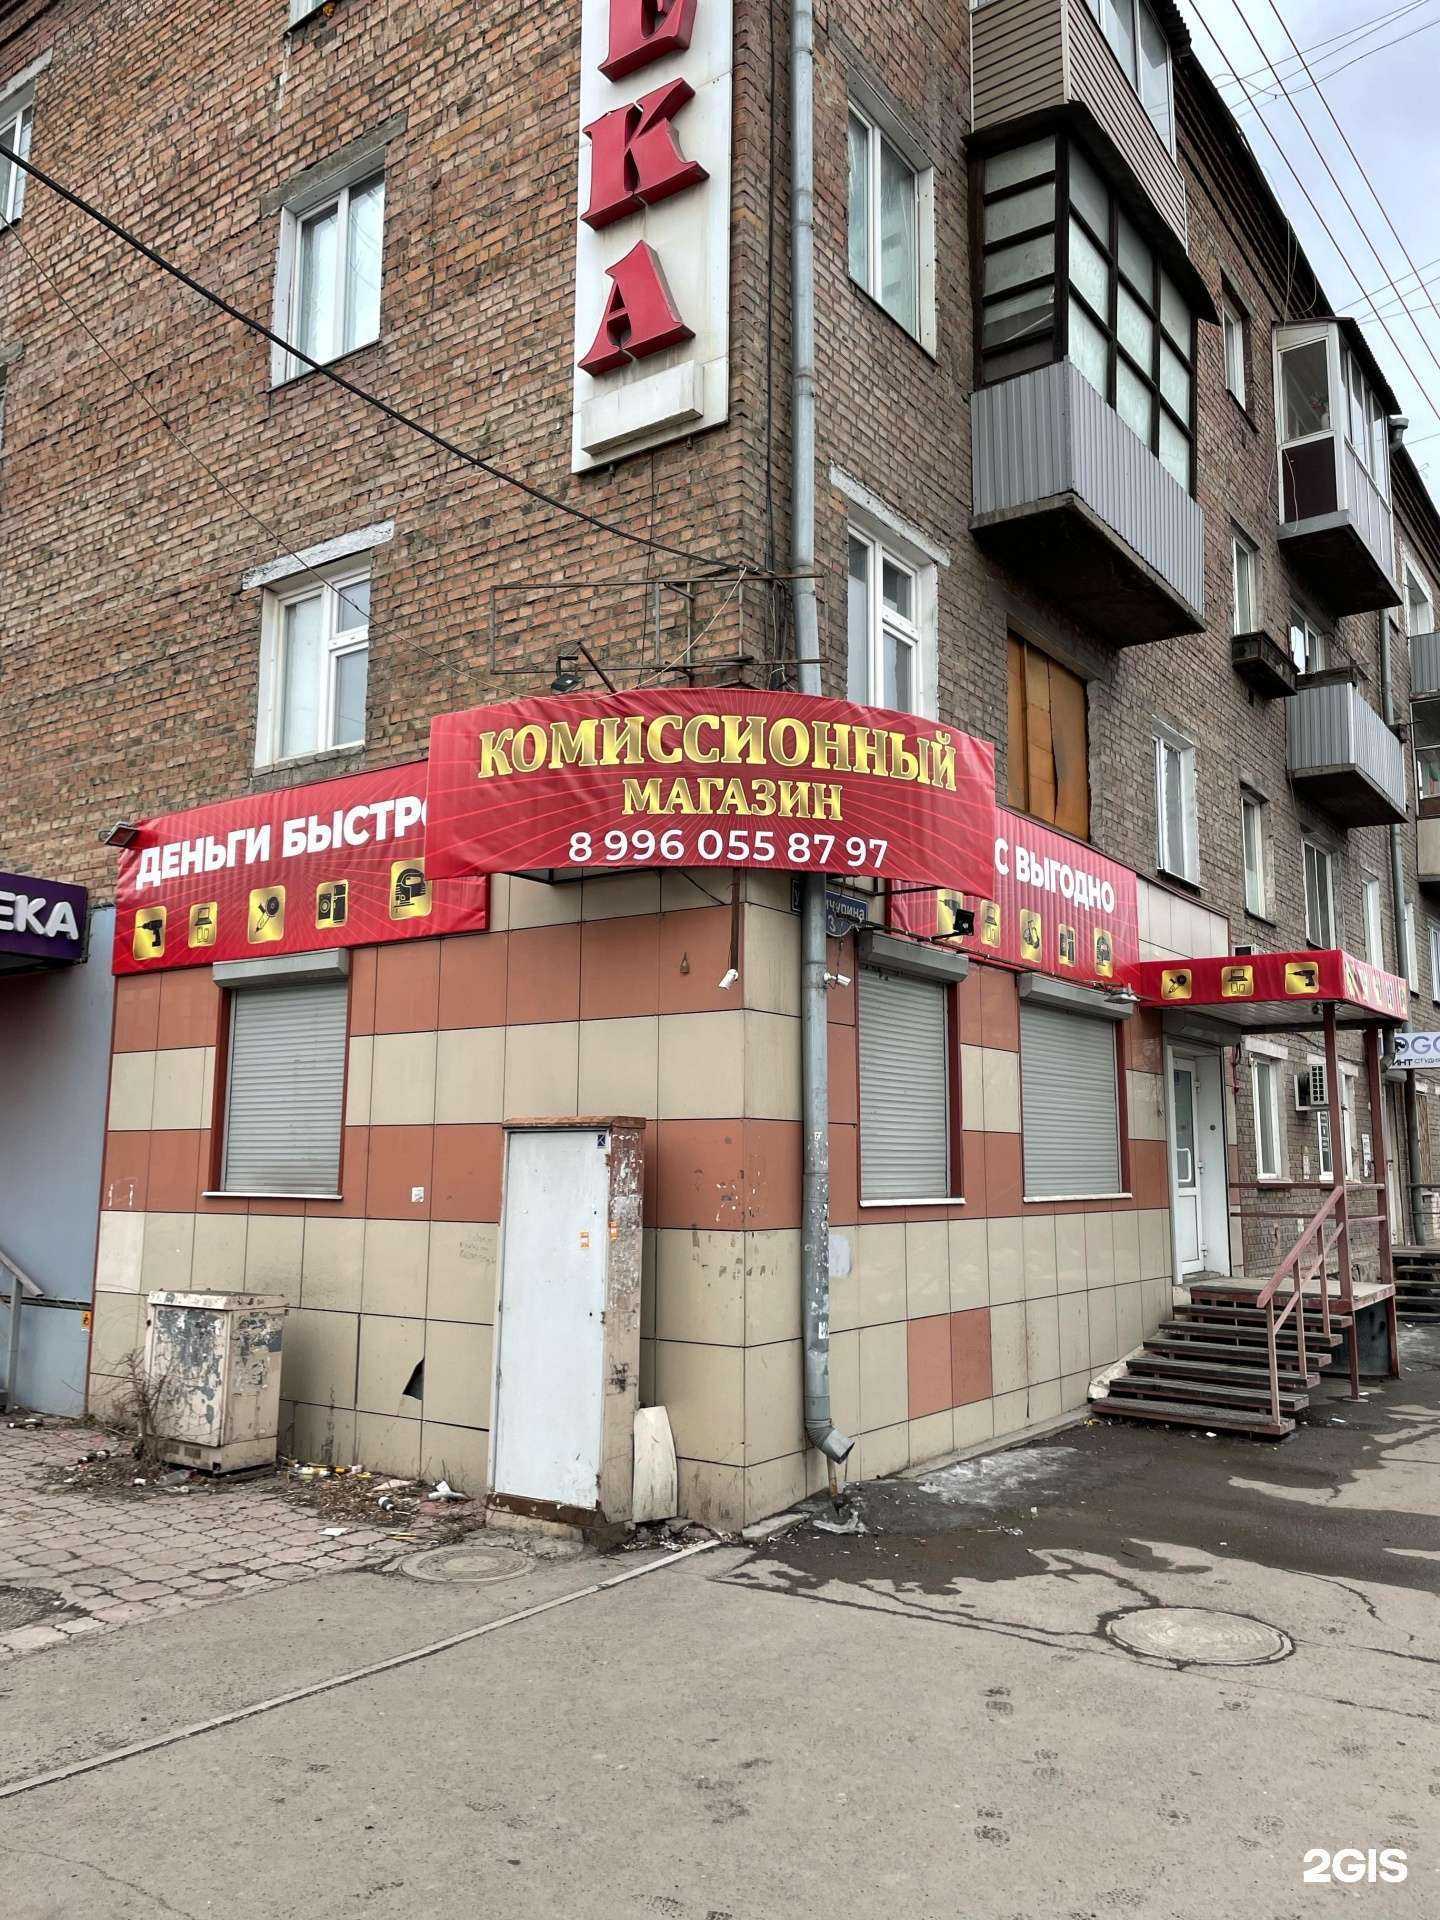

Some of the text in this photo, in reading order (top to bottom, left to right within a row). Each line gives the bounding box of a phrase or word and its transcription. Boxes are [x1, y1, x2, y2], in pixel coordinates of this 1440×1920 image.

[478, 714, 957, 792] КОМИССИОННЫЙ
[622, 777, 843, 821] МАГАЗИН
[135, 795, 427, 891] ДЕНЬГИ БЫСТР
[568, 829, 888, 868] 8 996 055 87 97
[1015, 844, 1118, 914] ВЫГОДНО
